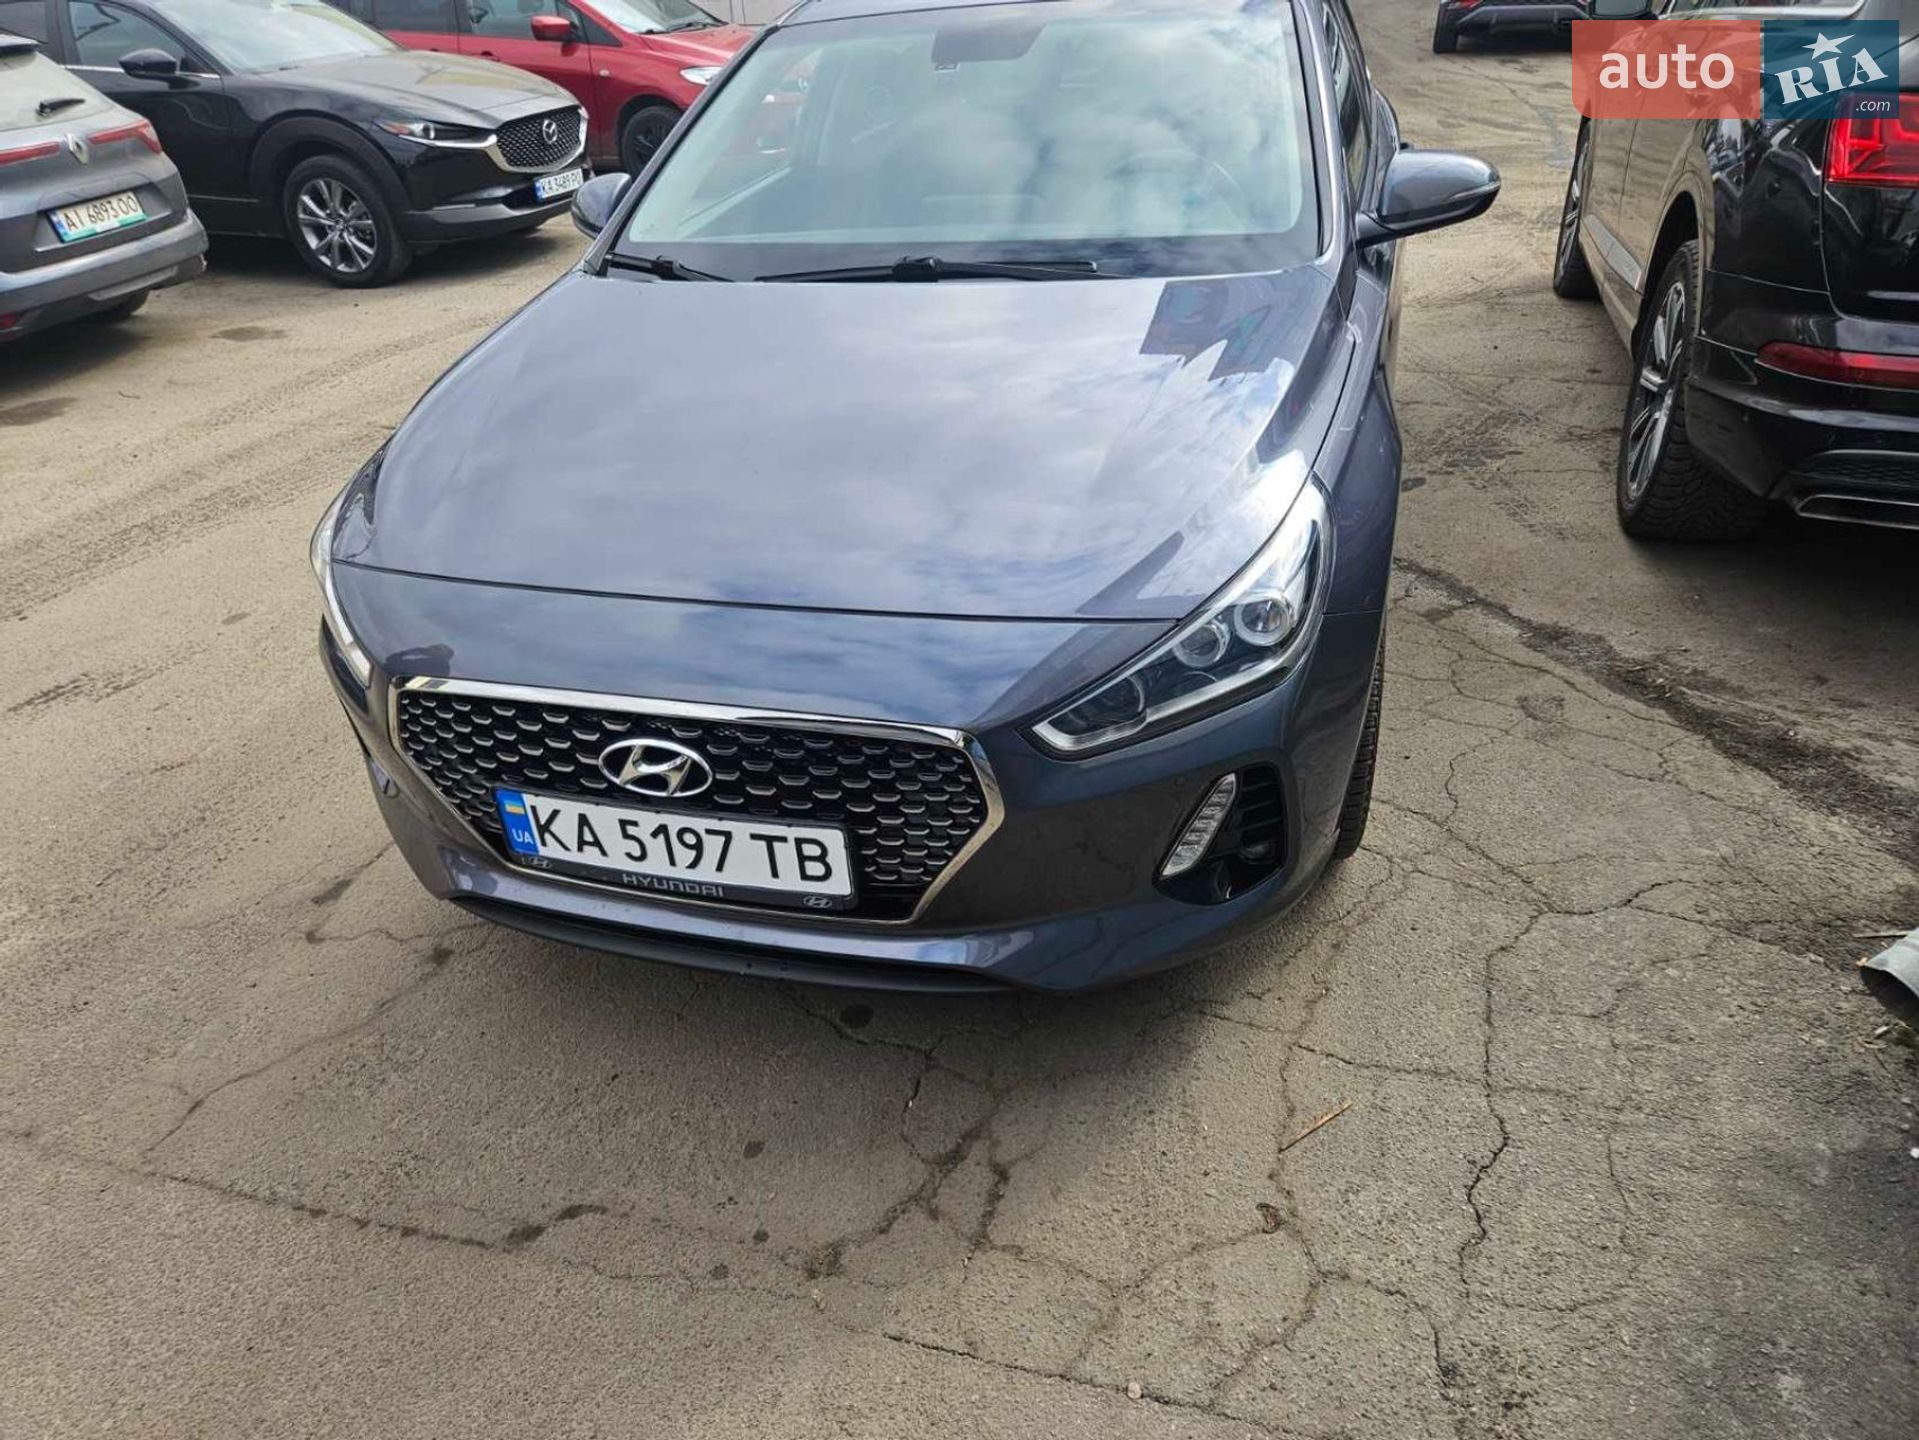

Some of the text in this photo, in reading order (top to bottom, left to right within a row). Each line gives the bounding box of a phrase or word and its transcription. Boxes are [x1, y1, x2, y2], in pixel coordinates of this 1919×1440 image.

[63, 208, 85, 231] AI
[87, 200, 118, 224] 6893
[512, 828, 535, 846] UA
[529, 804, 833, 883] KA 5197 TB
[621, 873, 725, 898] HYUNDAI
